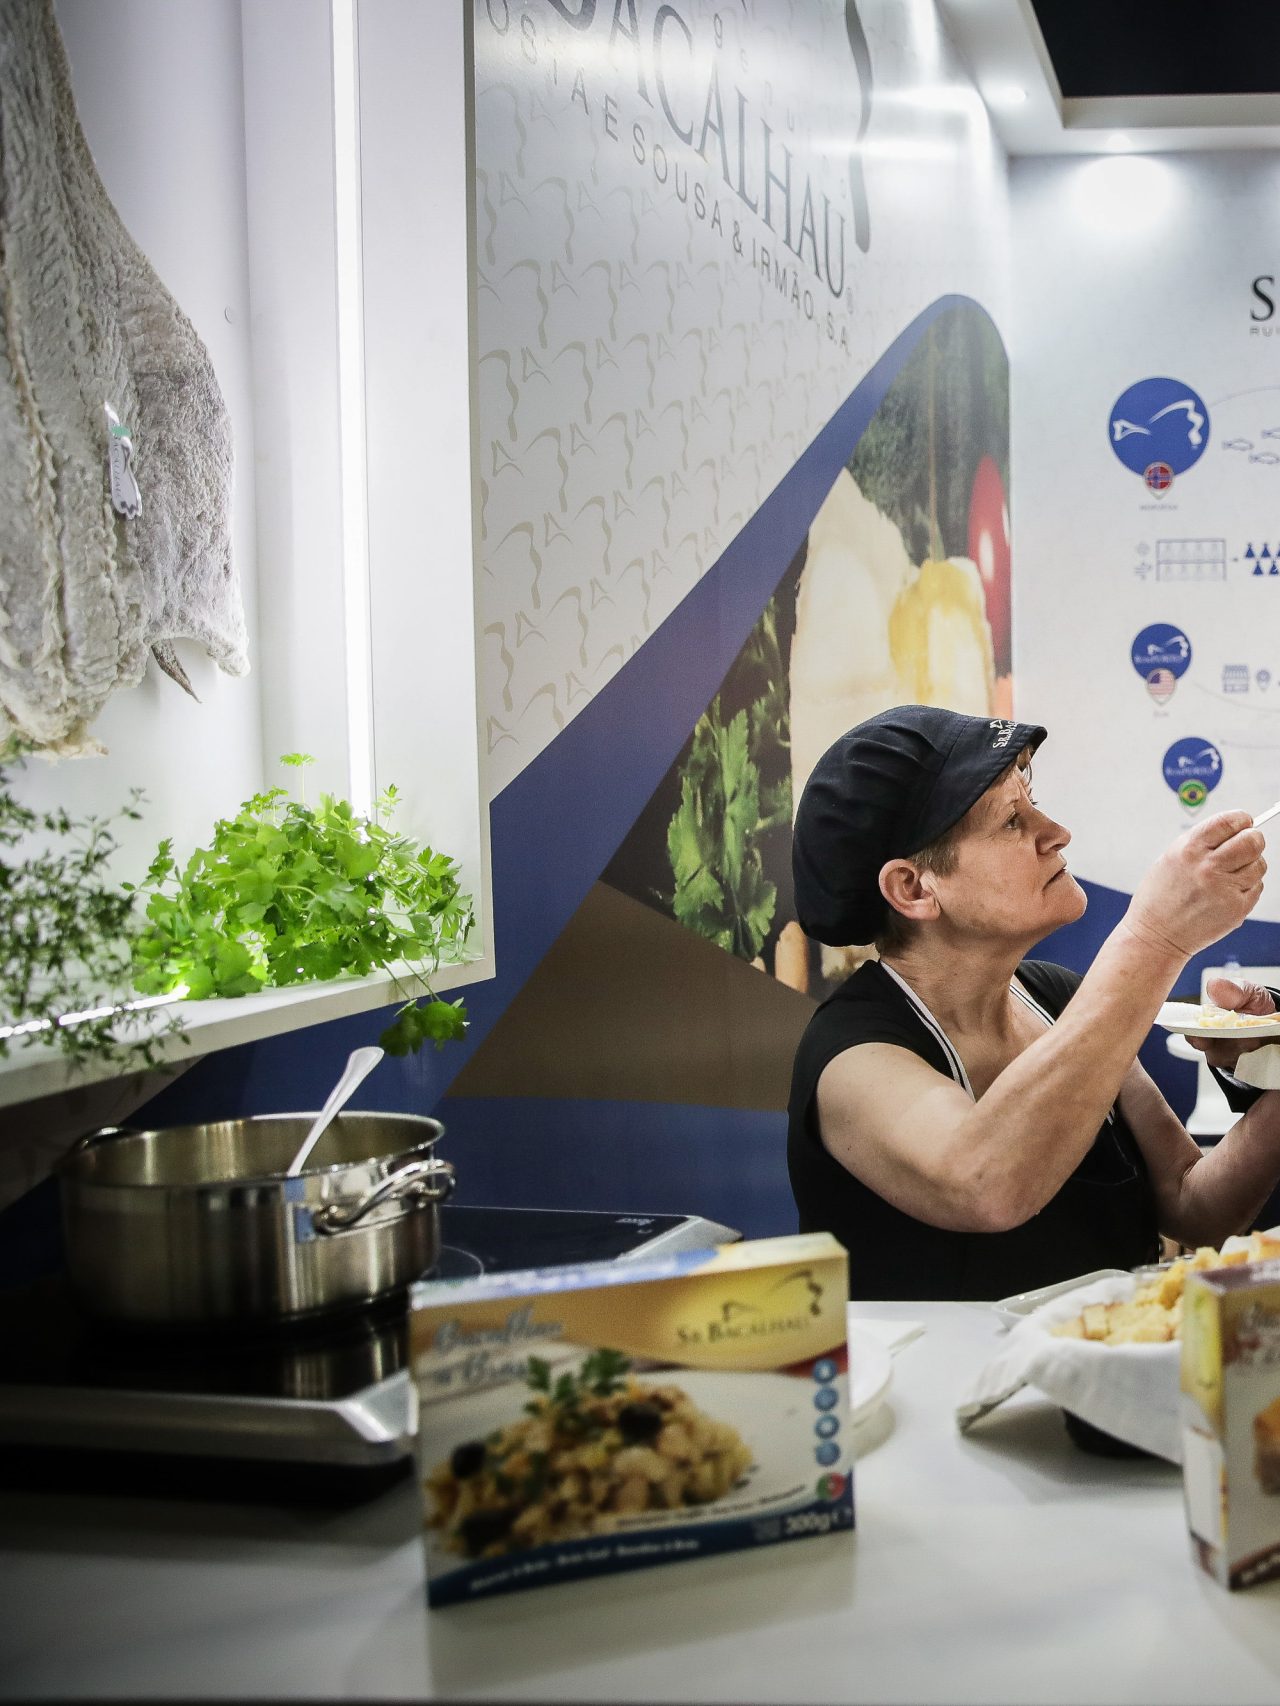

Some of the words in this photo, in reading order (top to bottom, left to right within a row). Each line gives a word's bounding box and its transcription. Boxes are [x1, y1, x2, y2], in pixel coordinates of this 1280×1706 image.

[486, 0, 590, 116] OSTA
[605, 94, 619, 142] E
[632, 123, 723, 237] SOUSA
[732, 220, 745, 257] &
